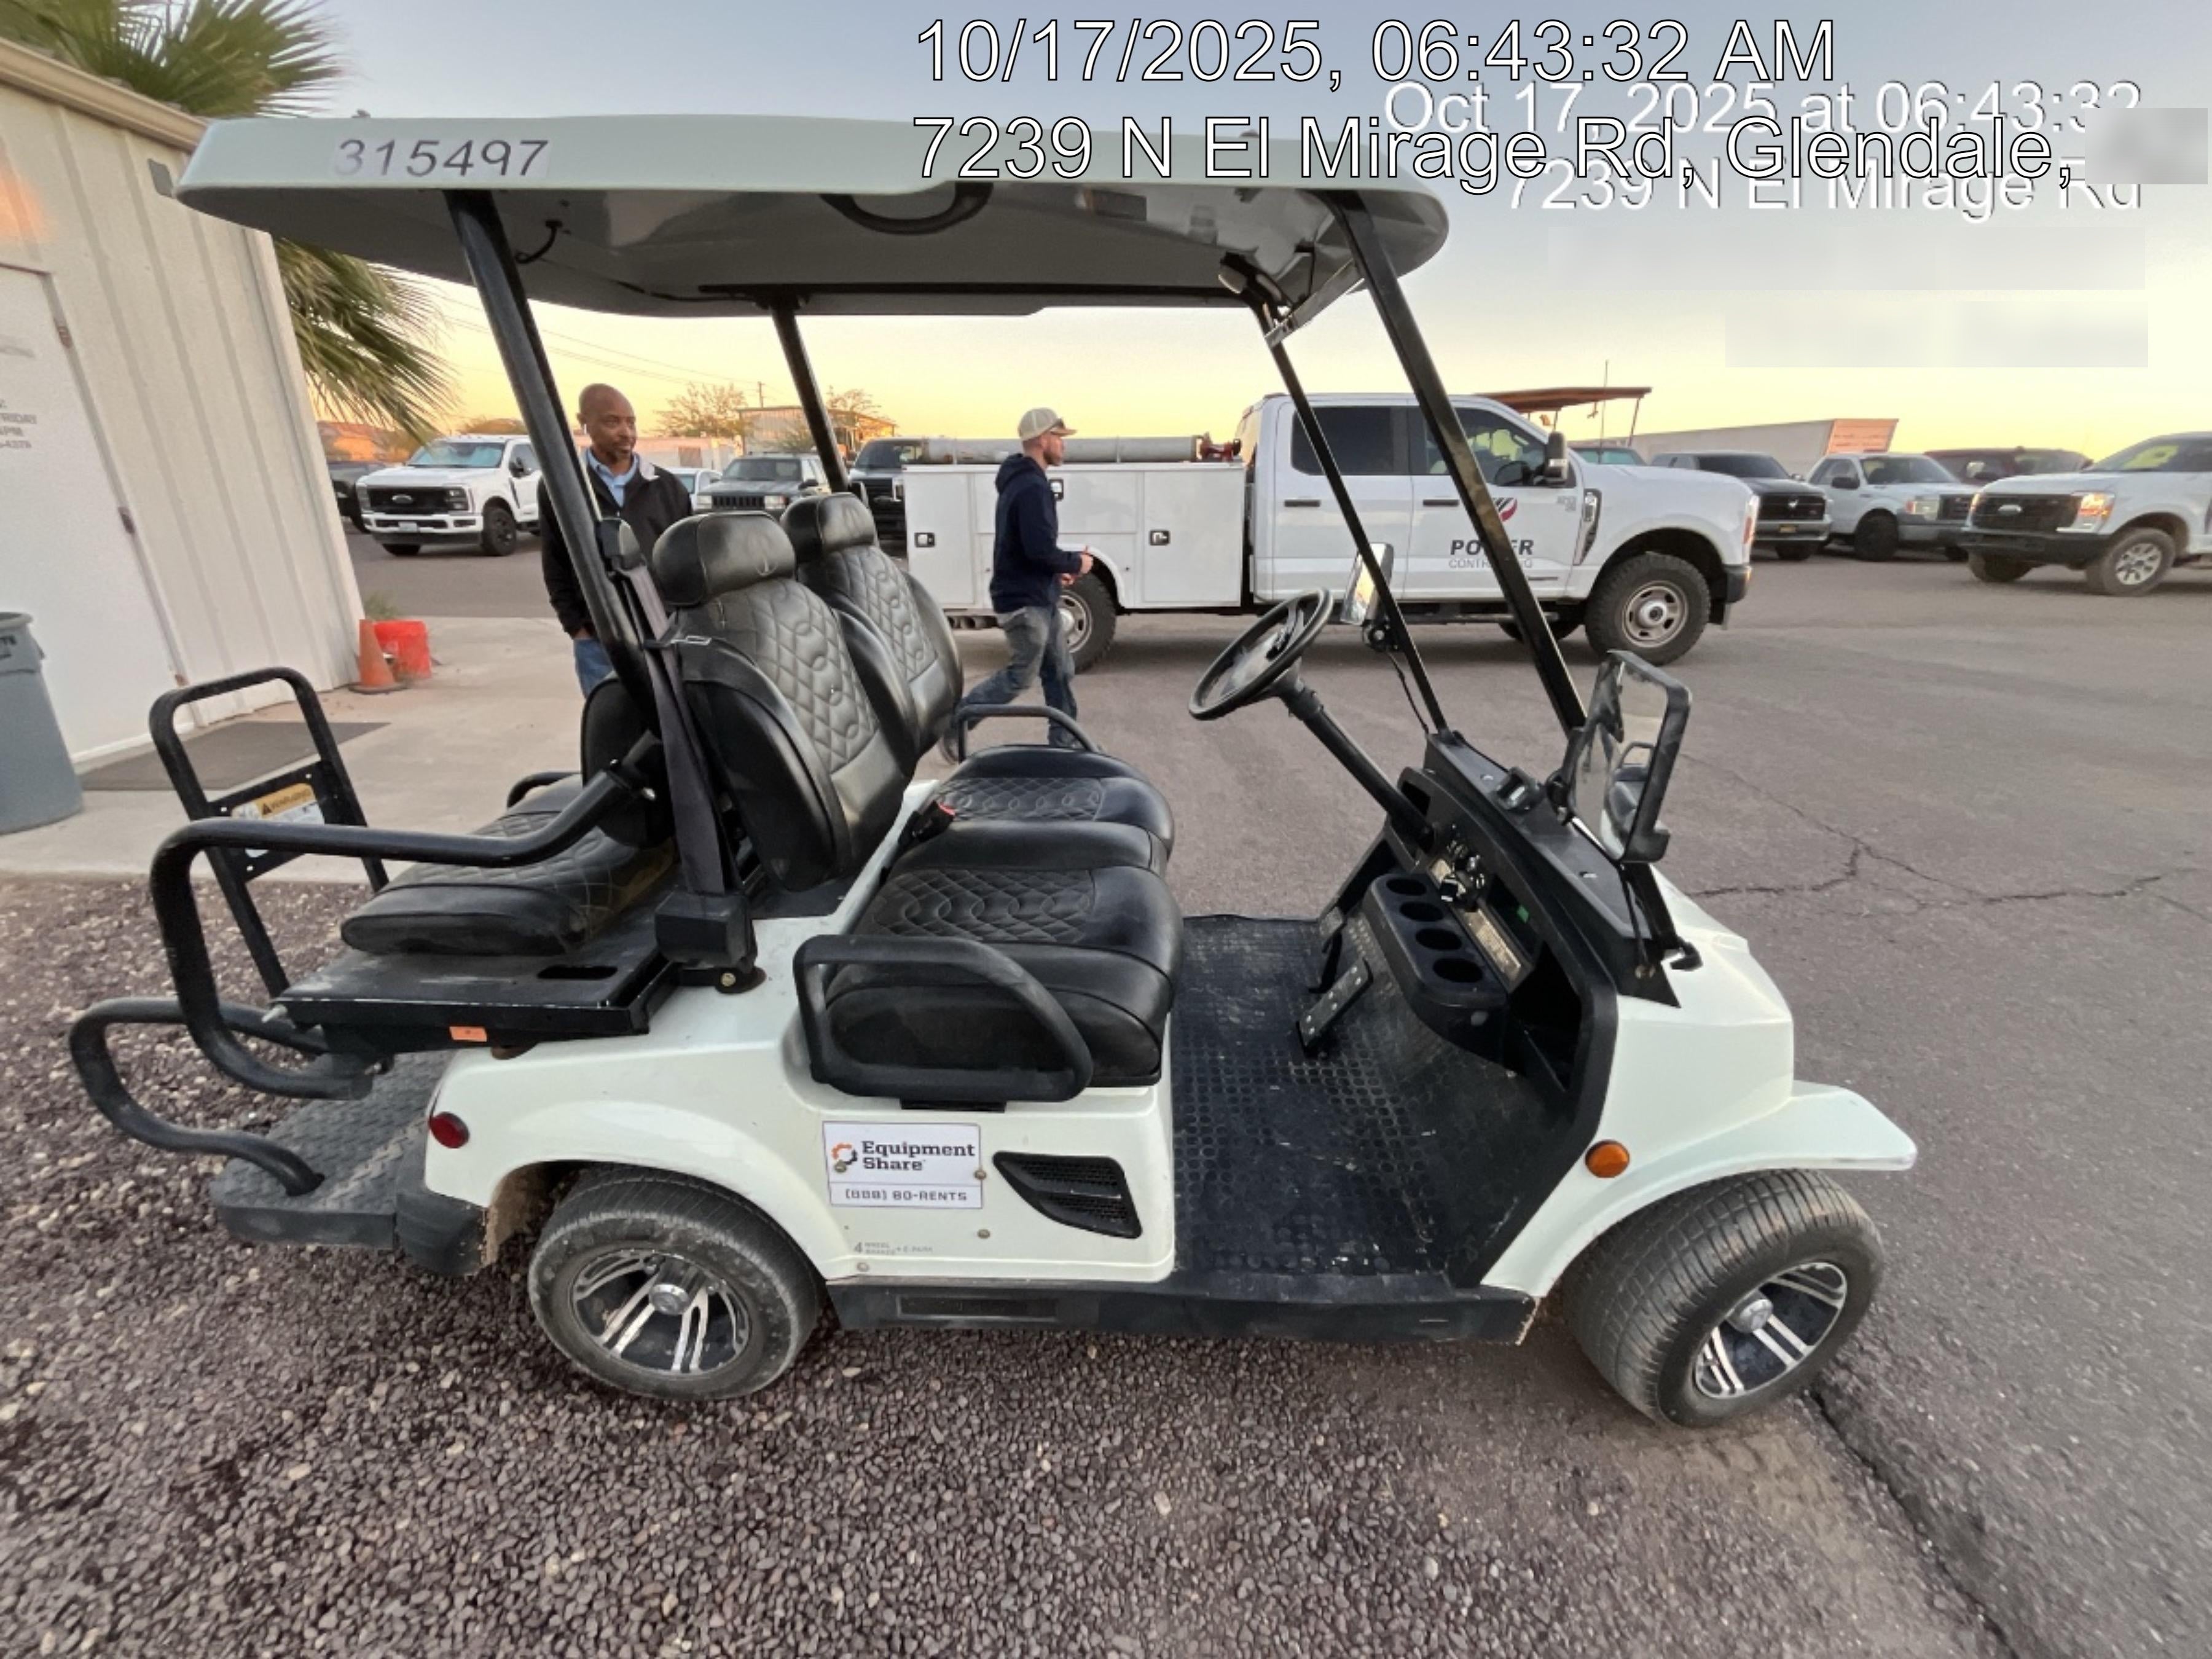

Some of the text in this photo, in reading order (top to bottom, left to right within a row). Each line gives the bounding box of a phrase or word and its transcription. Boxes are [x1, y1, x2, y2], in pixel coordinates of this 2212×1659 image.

[335, 138, 549, 177] 315497
[1450, 539, 1534, 555] POR
[861, 1140, 976, 1158] Equipment
[862, 1157, 923, 1171] Share
